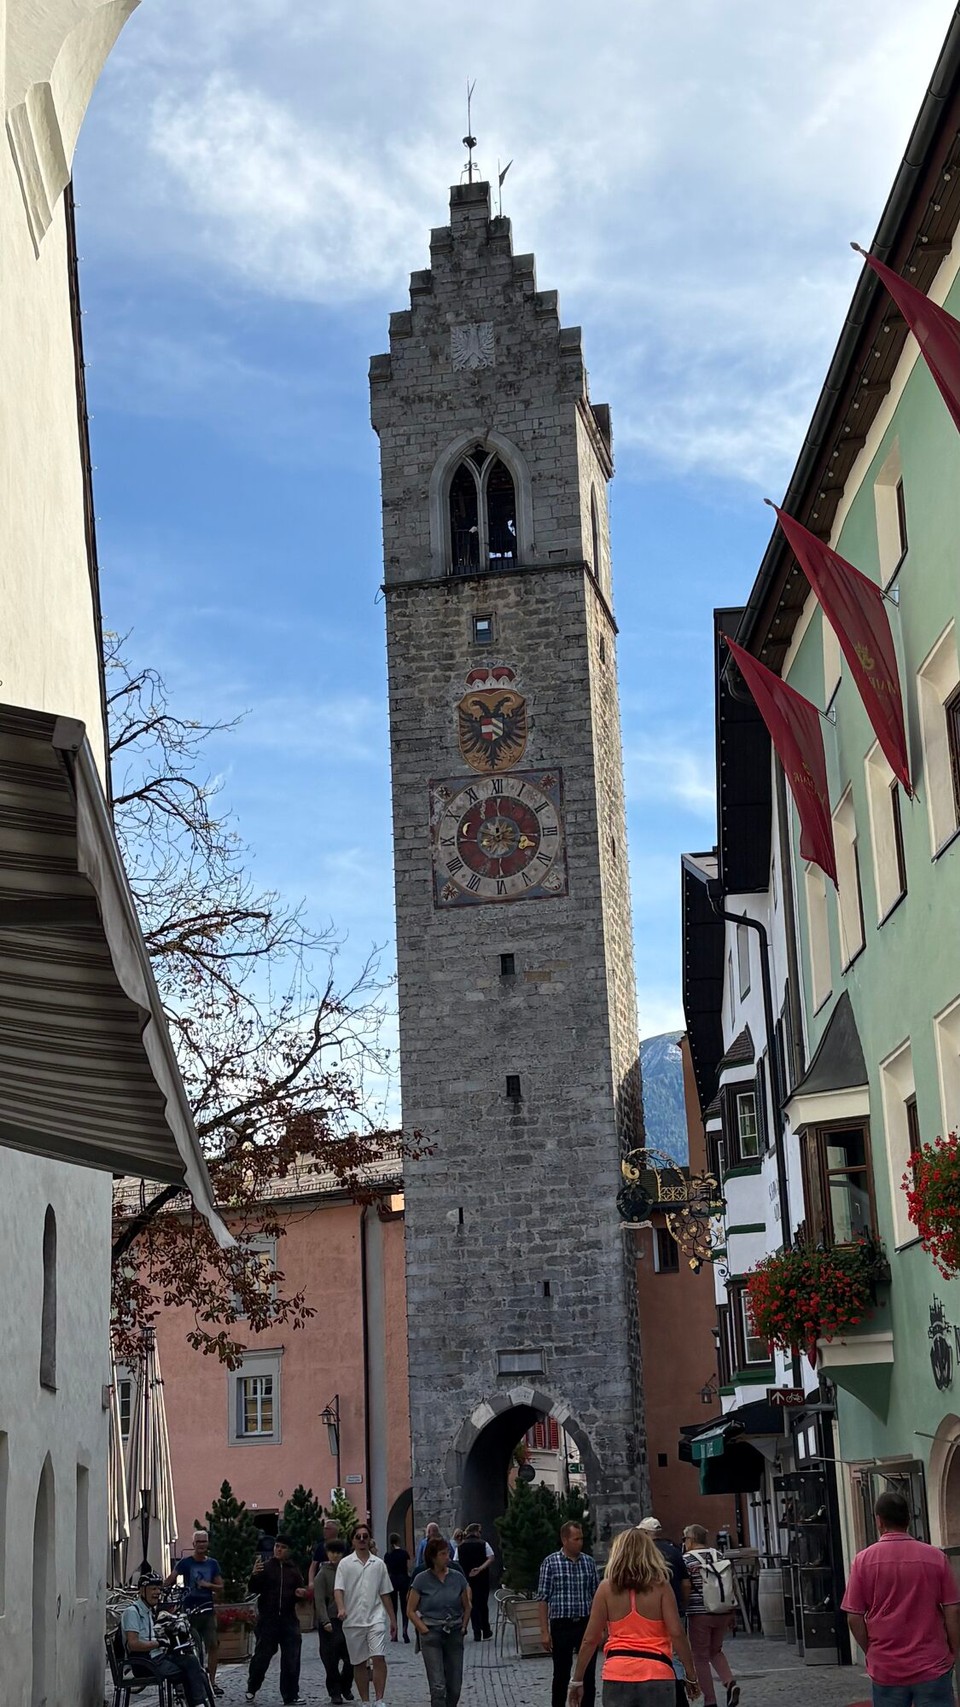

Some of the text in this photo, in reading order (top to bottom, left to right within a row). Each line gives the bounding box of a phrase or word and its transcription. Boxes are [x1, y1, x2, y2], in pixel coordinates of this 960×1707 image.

[491, 779, 503, 795] XII
[464, 787, 479, 805] XI
[534, 801, 549, 813] II
[445, 810, 461, 823] X
[543, 826, 558, 837] III
